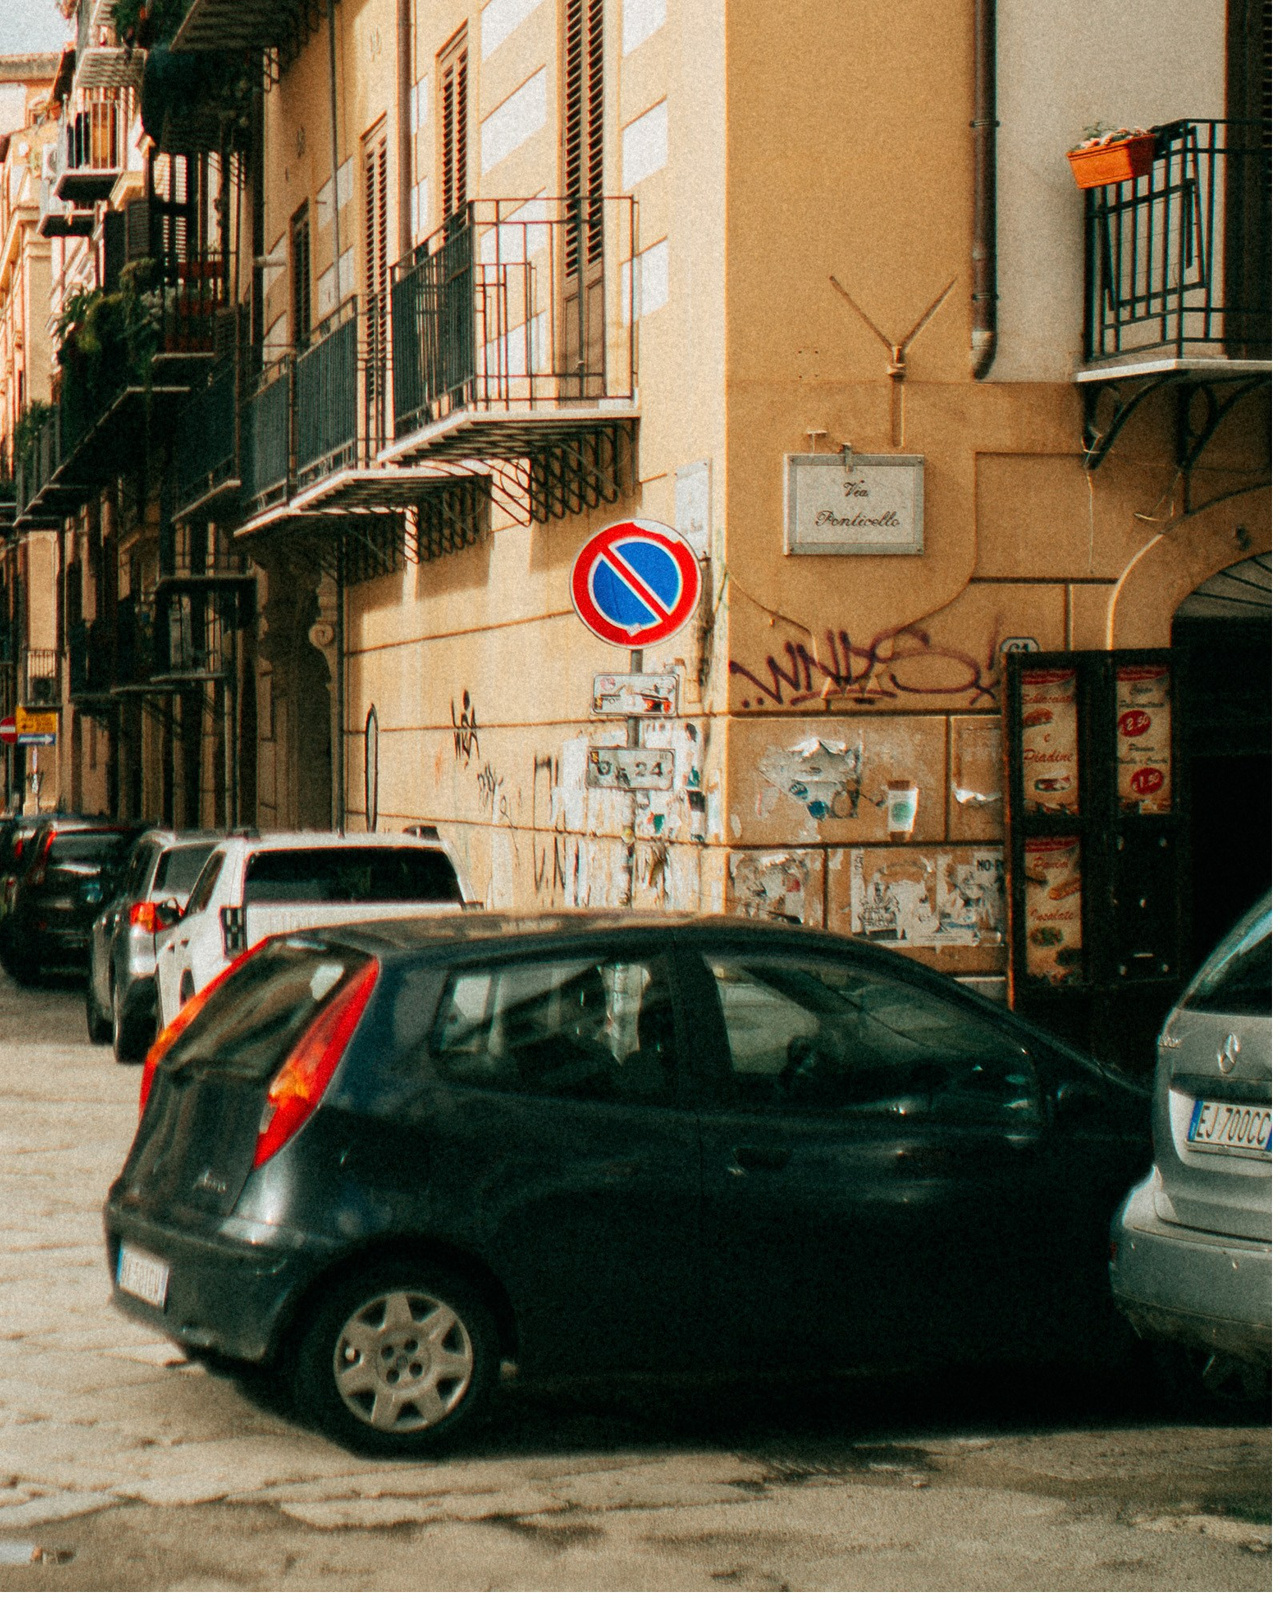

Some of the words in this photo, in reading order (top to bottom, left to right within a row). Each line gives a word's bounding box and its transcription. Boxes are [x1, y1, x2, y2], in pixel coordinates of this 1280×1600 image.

[843, 479, 869, 498] Via
[815, 509, 900, 527] Ponticello
[634, 761, 663, 777] 24
[1218, 1107, 1271, 1145] 700CC
